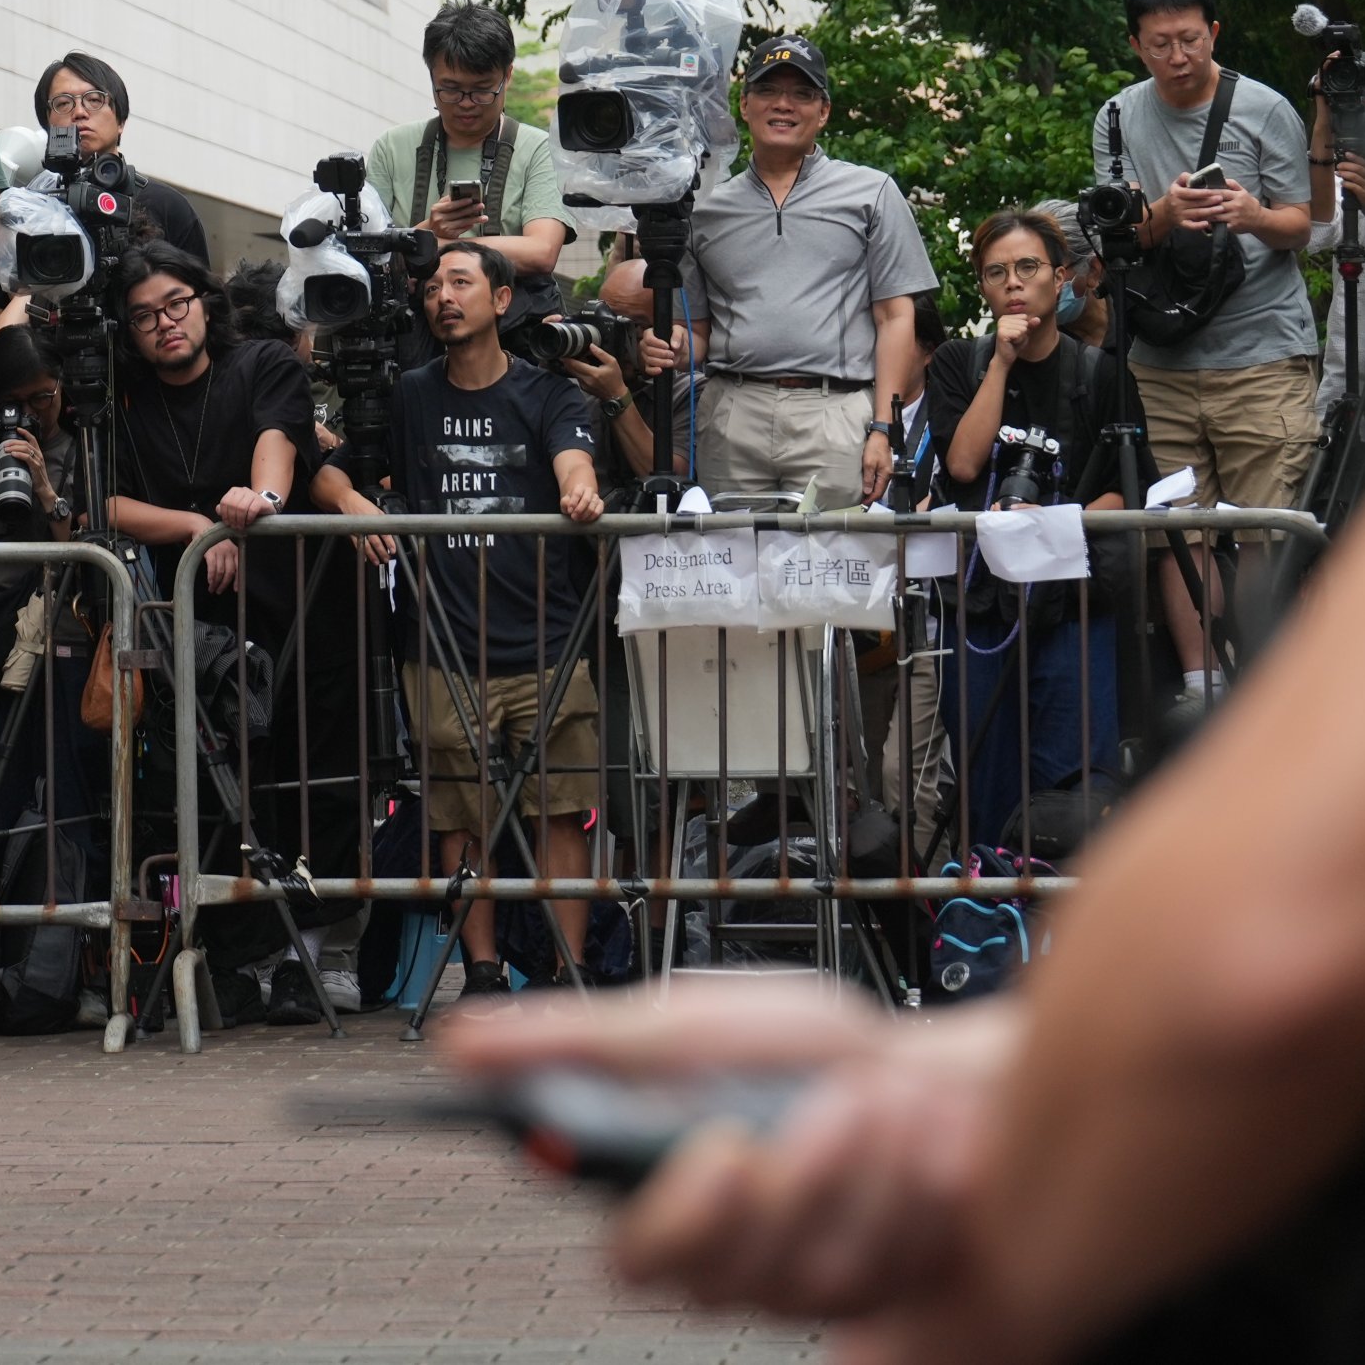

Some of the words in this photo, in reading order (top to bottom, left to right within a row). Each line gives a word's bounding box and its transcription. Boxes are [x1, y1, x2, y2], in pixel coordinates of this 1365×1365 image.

[762, 50, 791, 65] J-16
[443, 416, 493, 438] GAINS
[441, 472, 497, 493] AREN'T
[643, 547, 733, 571] Designated
[783, 558, 872, 587] 記者區
[645, 582, 687, 599] Press
[692, 579, 733, 596] Area
